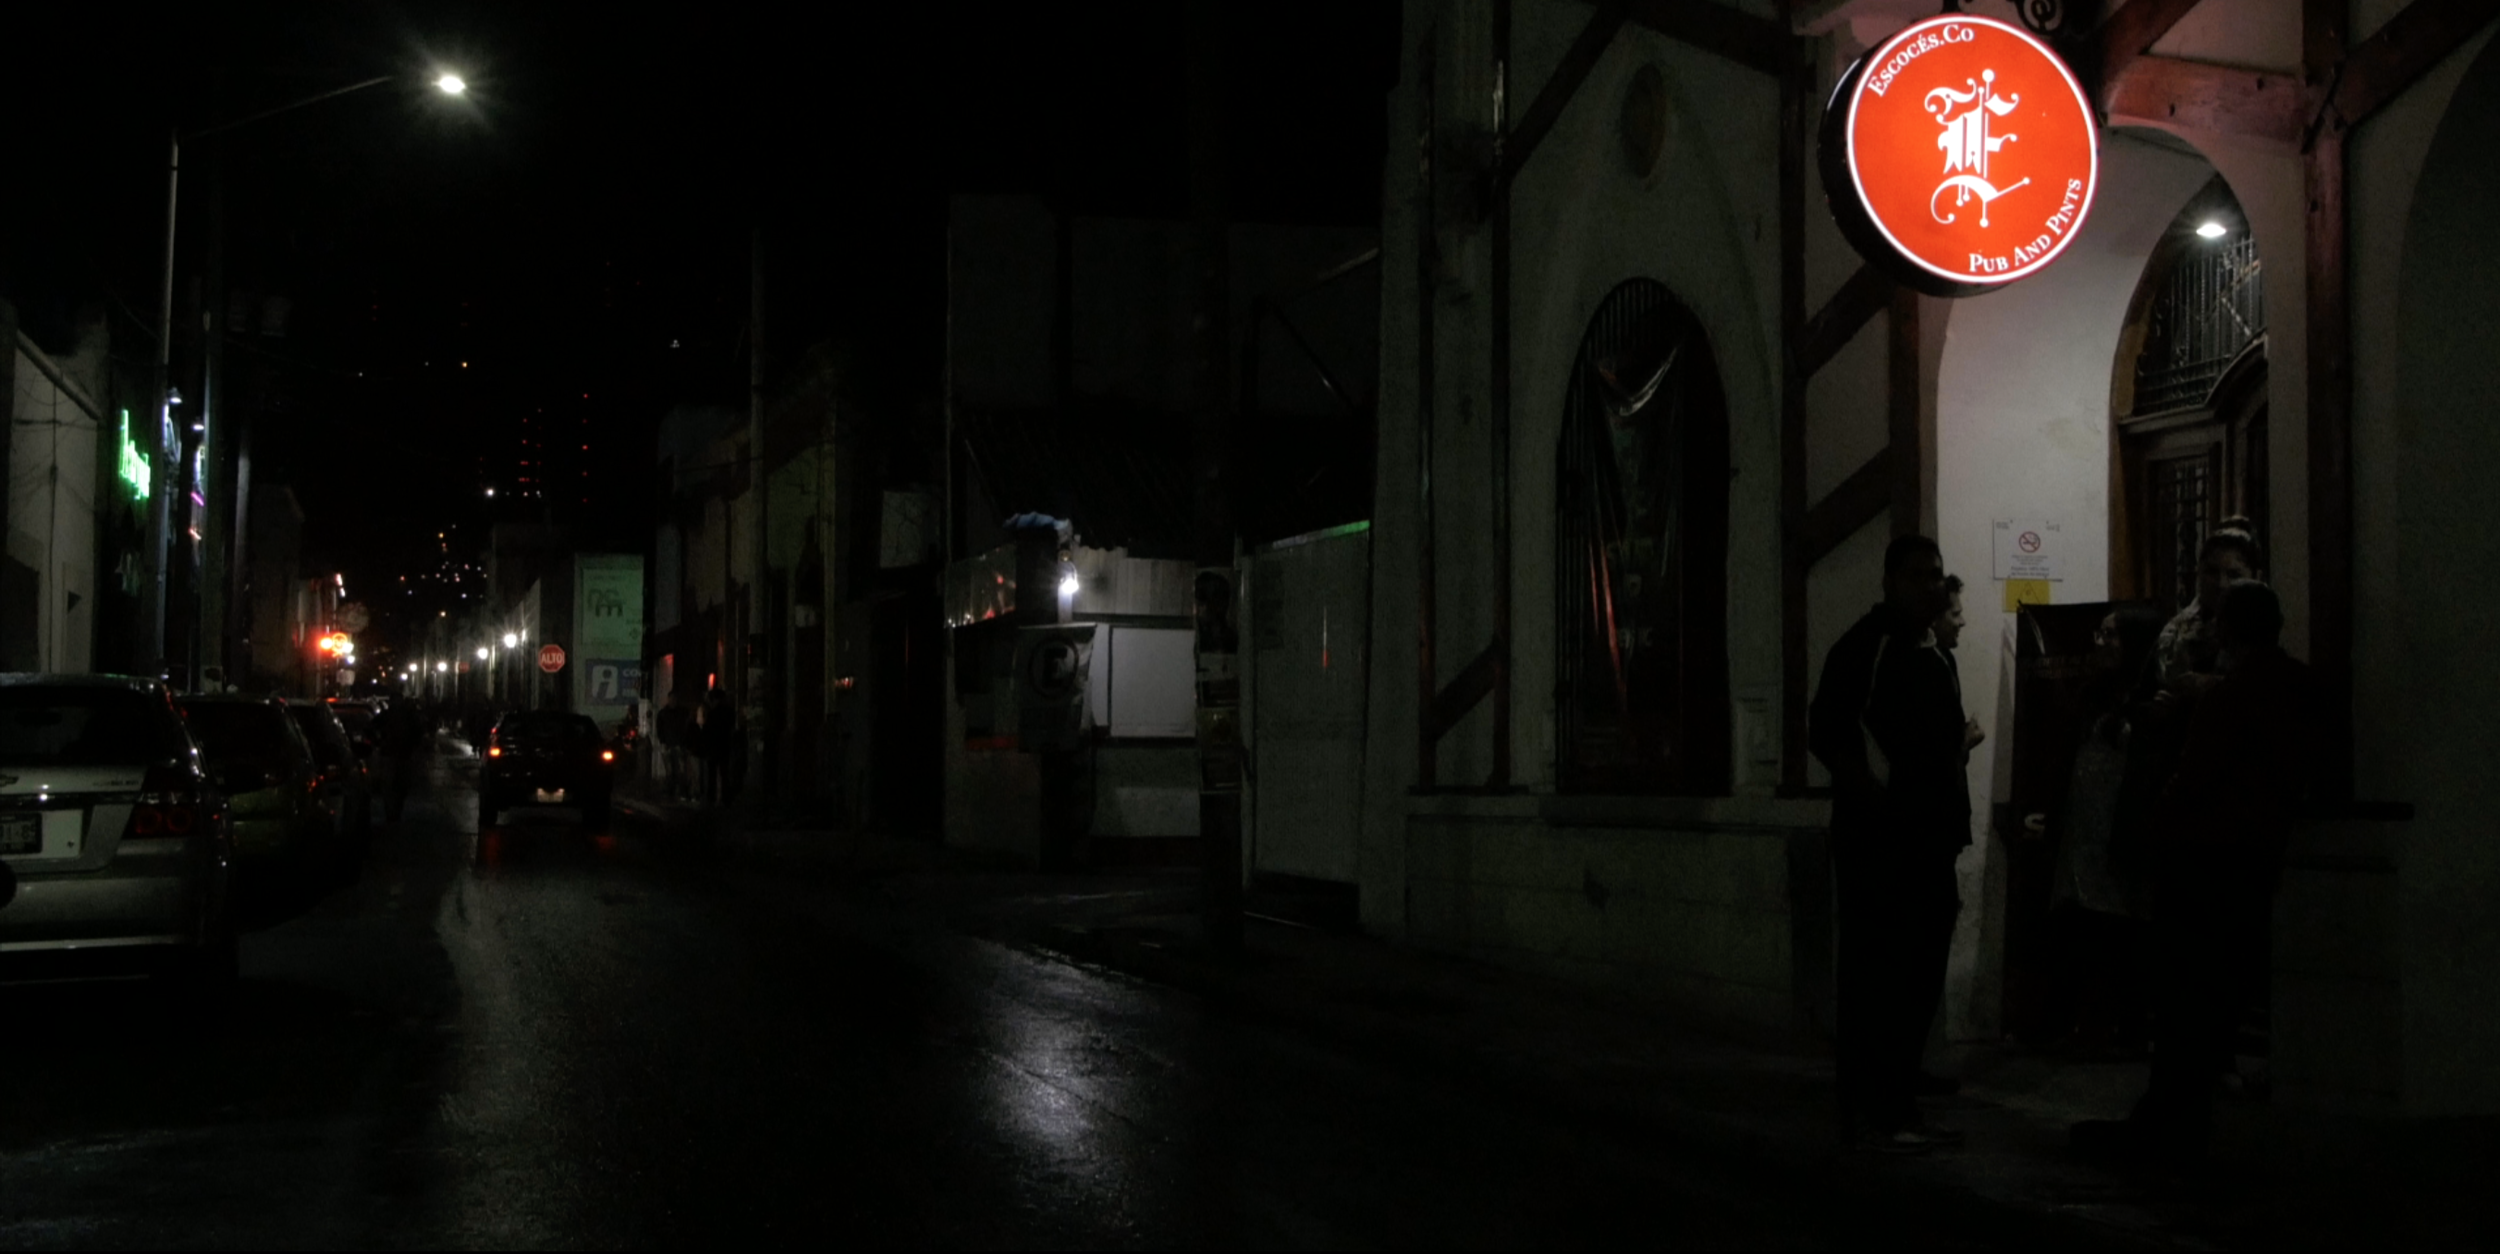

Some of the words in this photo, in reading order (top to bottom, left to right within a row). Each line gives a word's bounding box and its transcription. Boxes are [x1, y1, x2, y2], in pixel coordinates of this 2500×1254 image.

[1968, 252, 2009, 273] PUB
[2013, 235, 2051, 267] AND
[2046, 178, 2082, 235] PINTS
[541, 652, 563, 665] ALTO
